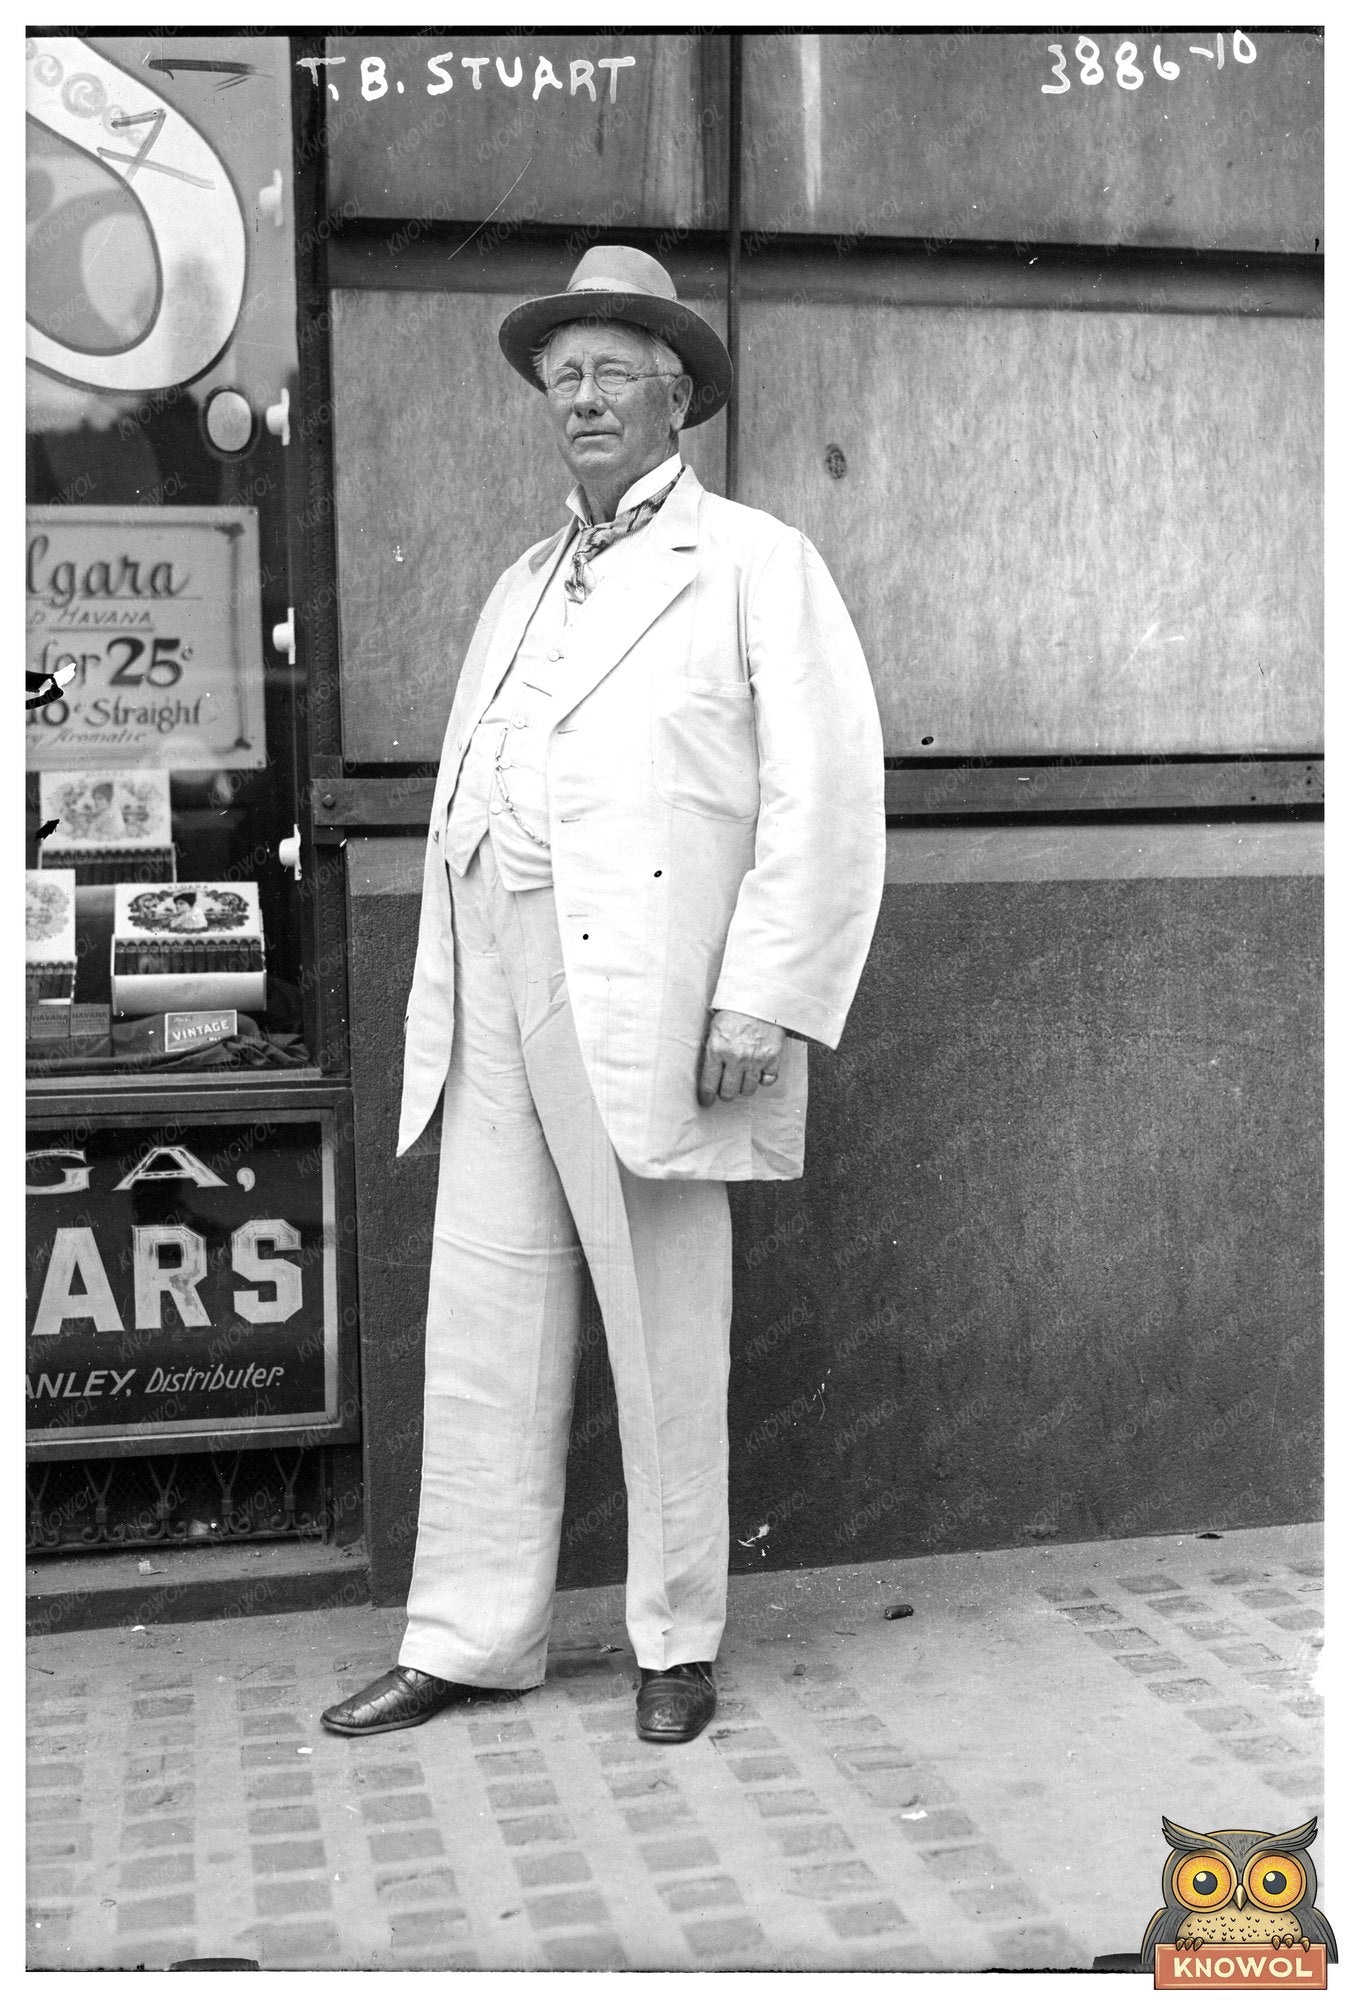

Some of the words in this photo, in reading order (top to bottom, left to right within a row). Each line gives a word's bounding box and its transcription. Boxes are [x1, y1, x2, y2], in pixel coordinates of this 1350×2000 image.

[1041, 30, 1257, 94] 3886-10
[361, 56, 404, 101] B.
[427, 52, 635, 103] STUART
[58, 606, 152, 625] HAVANA
[84, 694, 203, 734] Straight
[71, 1011, 108, 1020] HAVANA
[172, 1020, 229, 1040] VINTAGE
